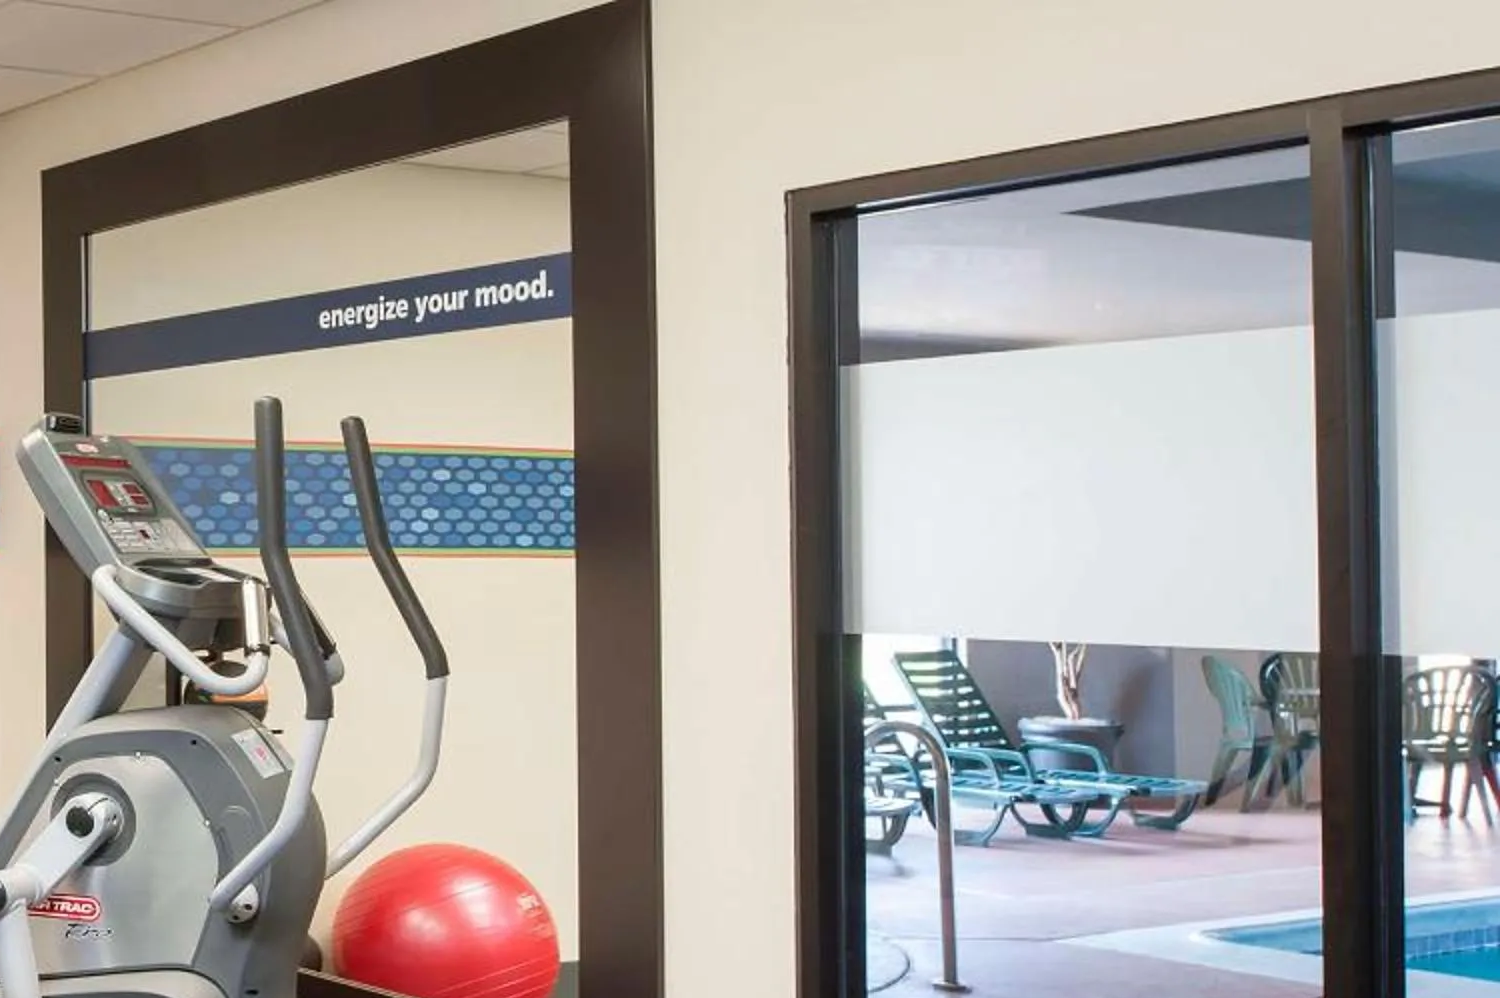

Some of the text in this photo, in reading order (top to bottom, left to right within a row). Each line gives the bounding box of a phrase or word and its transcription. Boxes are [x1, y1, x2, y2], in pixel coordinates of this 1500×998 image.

[319, 269, 555, 329] energize your mood.
